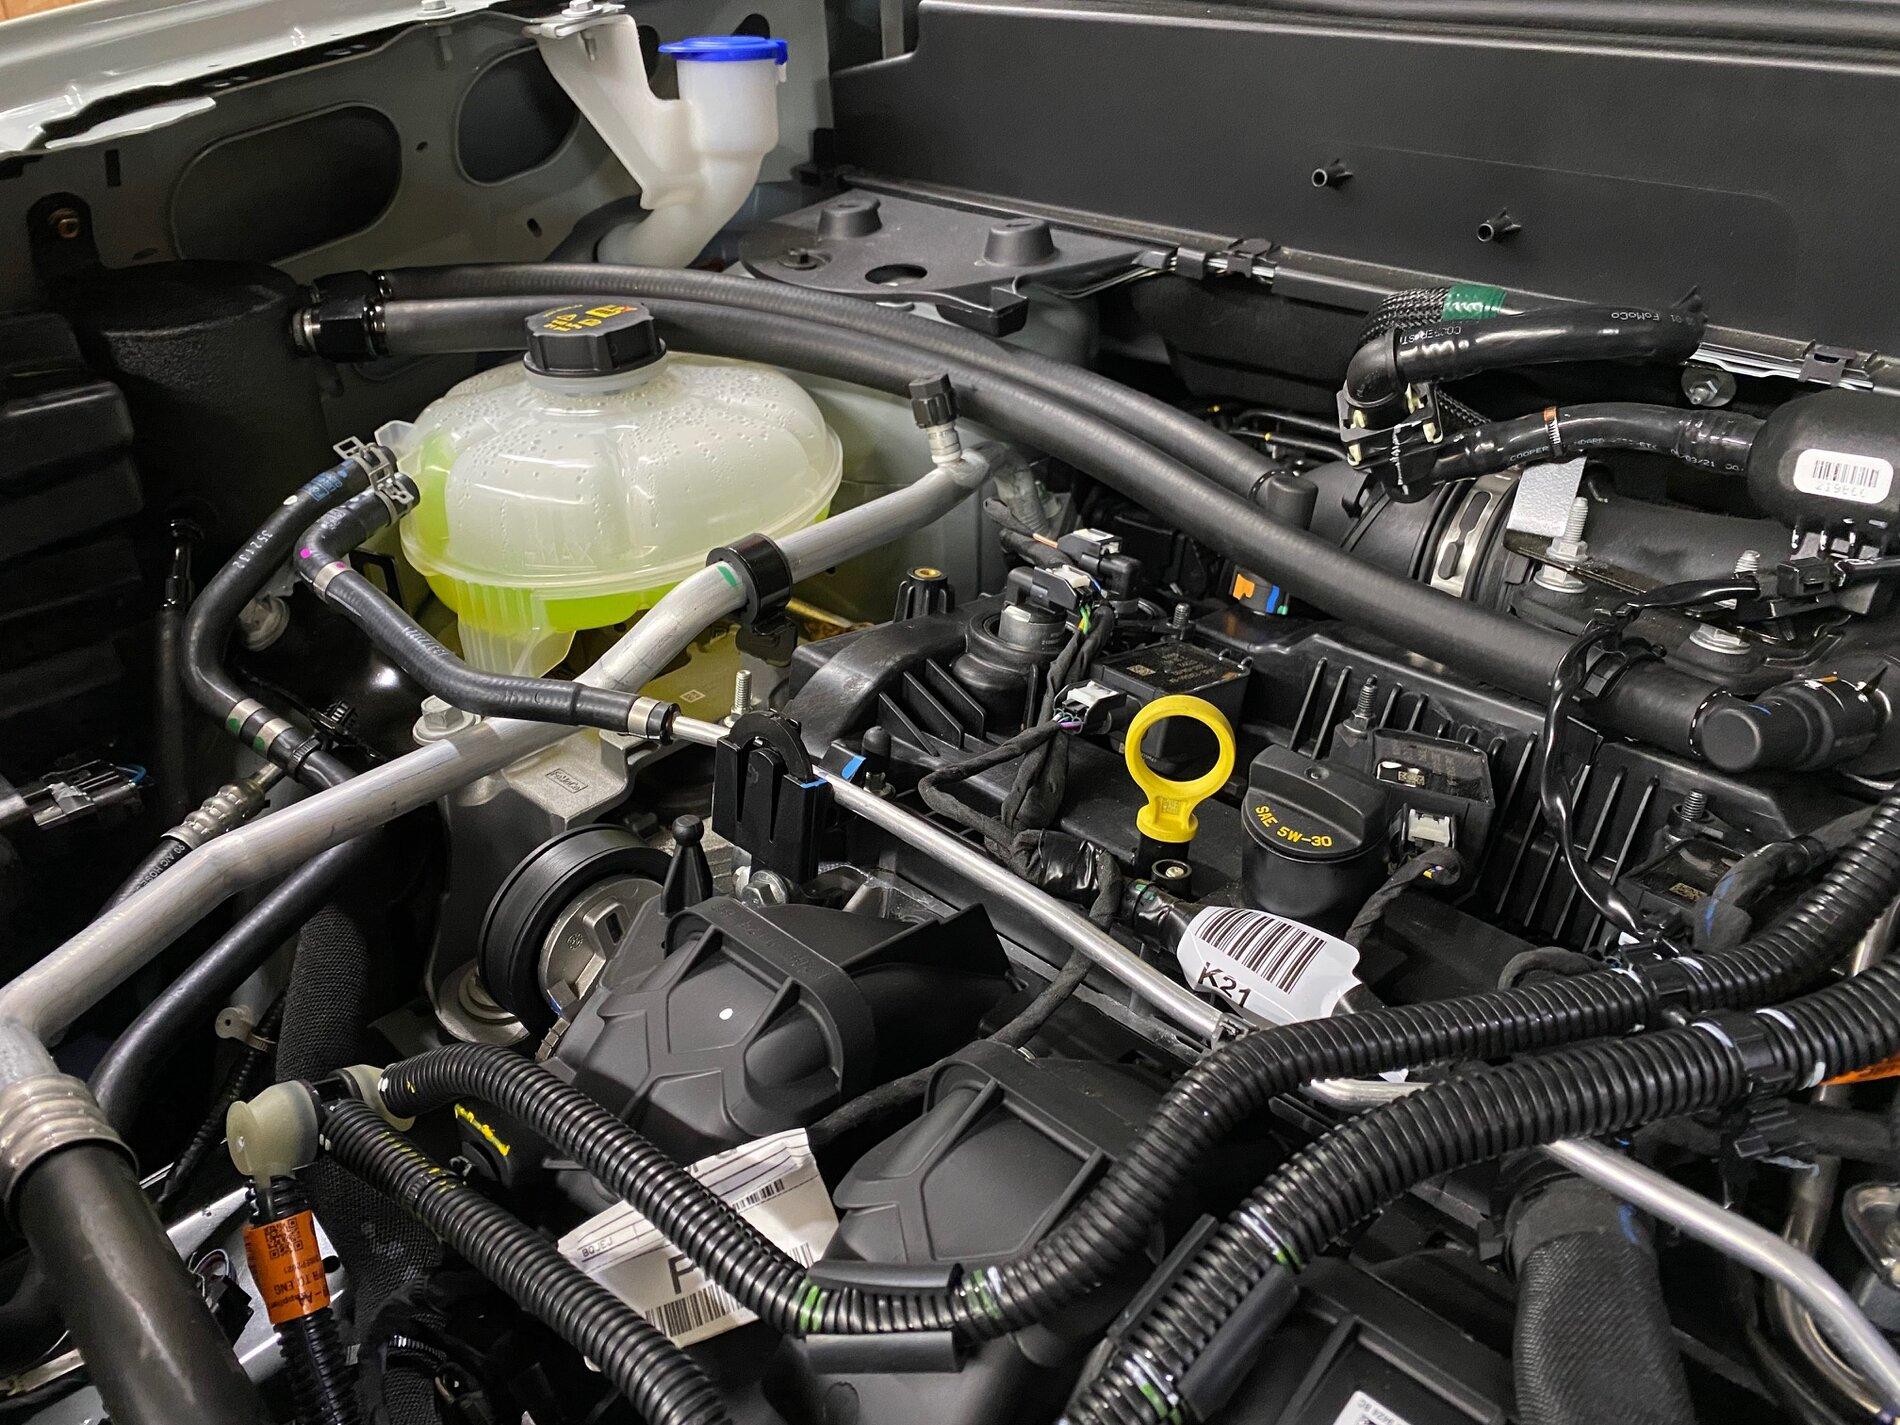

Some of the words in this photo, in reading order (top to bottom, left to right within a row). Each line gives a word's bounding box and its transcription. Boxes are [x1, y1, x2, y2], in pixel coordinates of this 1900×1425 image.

[1610, 311, 1660, 322] FoMoCo
[1509, 445, 1551, 461] COOPER
[1254, 805, 1279, 828] SAE
[1276, 826, 1333, 847] 5W-30
[1198, 962, 1252, 1009] K21
[274, 1281, 294, 1295] ENG
